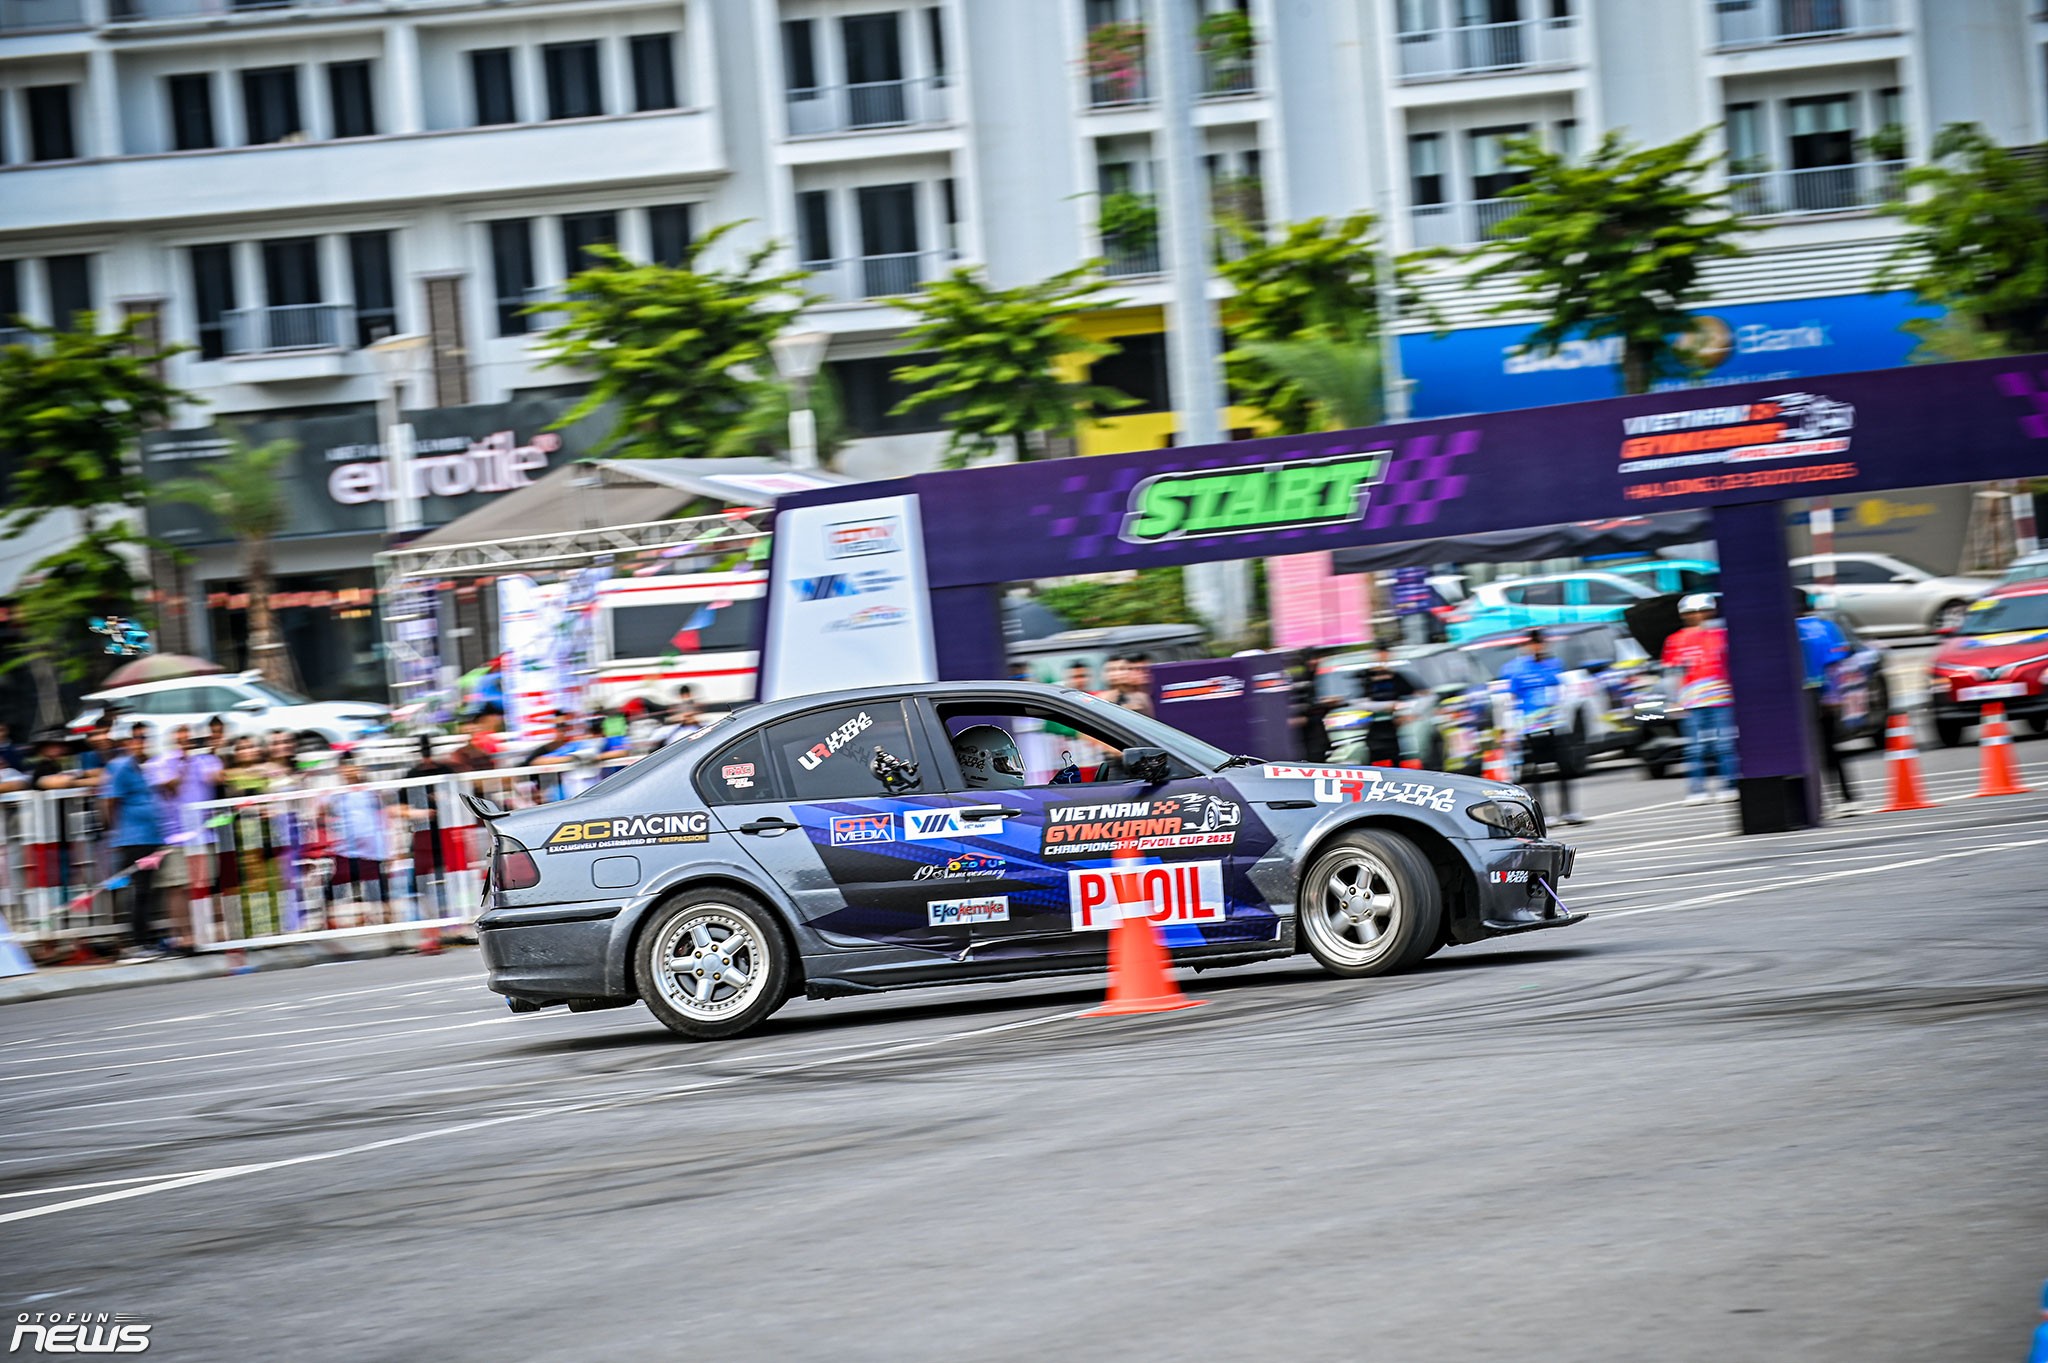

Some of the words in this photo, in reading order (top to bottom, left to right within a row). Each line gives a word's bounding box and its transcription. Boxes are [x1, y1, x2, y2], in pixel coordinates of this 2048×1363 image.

[1128, 459, 1383, 537] START
[1272, 767, 1375, 780] PVOIL
[1314, 779, 1365, 803] UR
[1371, 780, 1455, 800] ULTRA
[1364, 791, 1456, 812] RACING
[1050, 802, 1150, 822] VIETNAM
[550, 821, 611, 843] BC
[613, 815, 707, 837] RACING
[836, 816, 889, 832] OTV
[1045, 817, 1183, 843] GYMKHANA
[549, 842, 597, 853] EXCLUSIVELY
[598, 838, 645, 848] DISTRIBUTED
[836, 829, 891, 842] MEDIA
[1044, 839, 1139, 855] CHAMPIONSHIP
[1140, 838, 1178, 849] PVOIL
[1178, 836, 1204, 845] CUP
[1206, 833, 1232, 843] 2025
[932, 901, 1005, 922] Ekokemika
